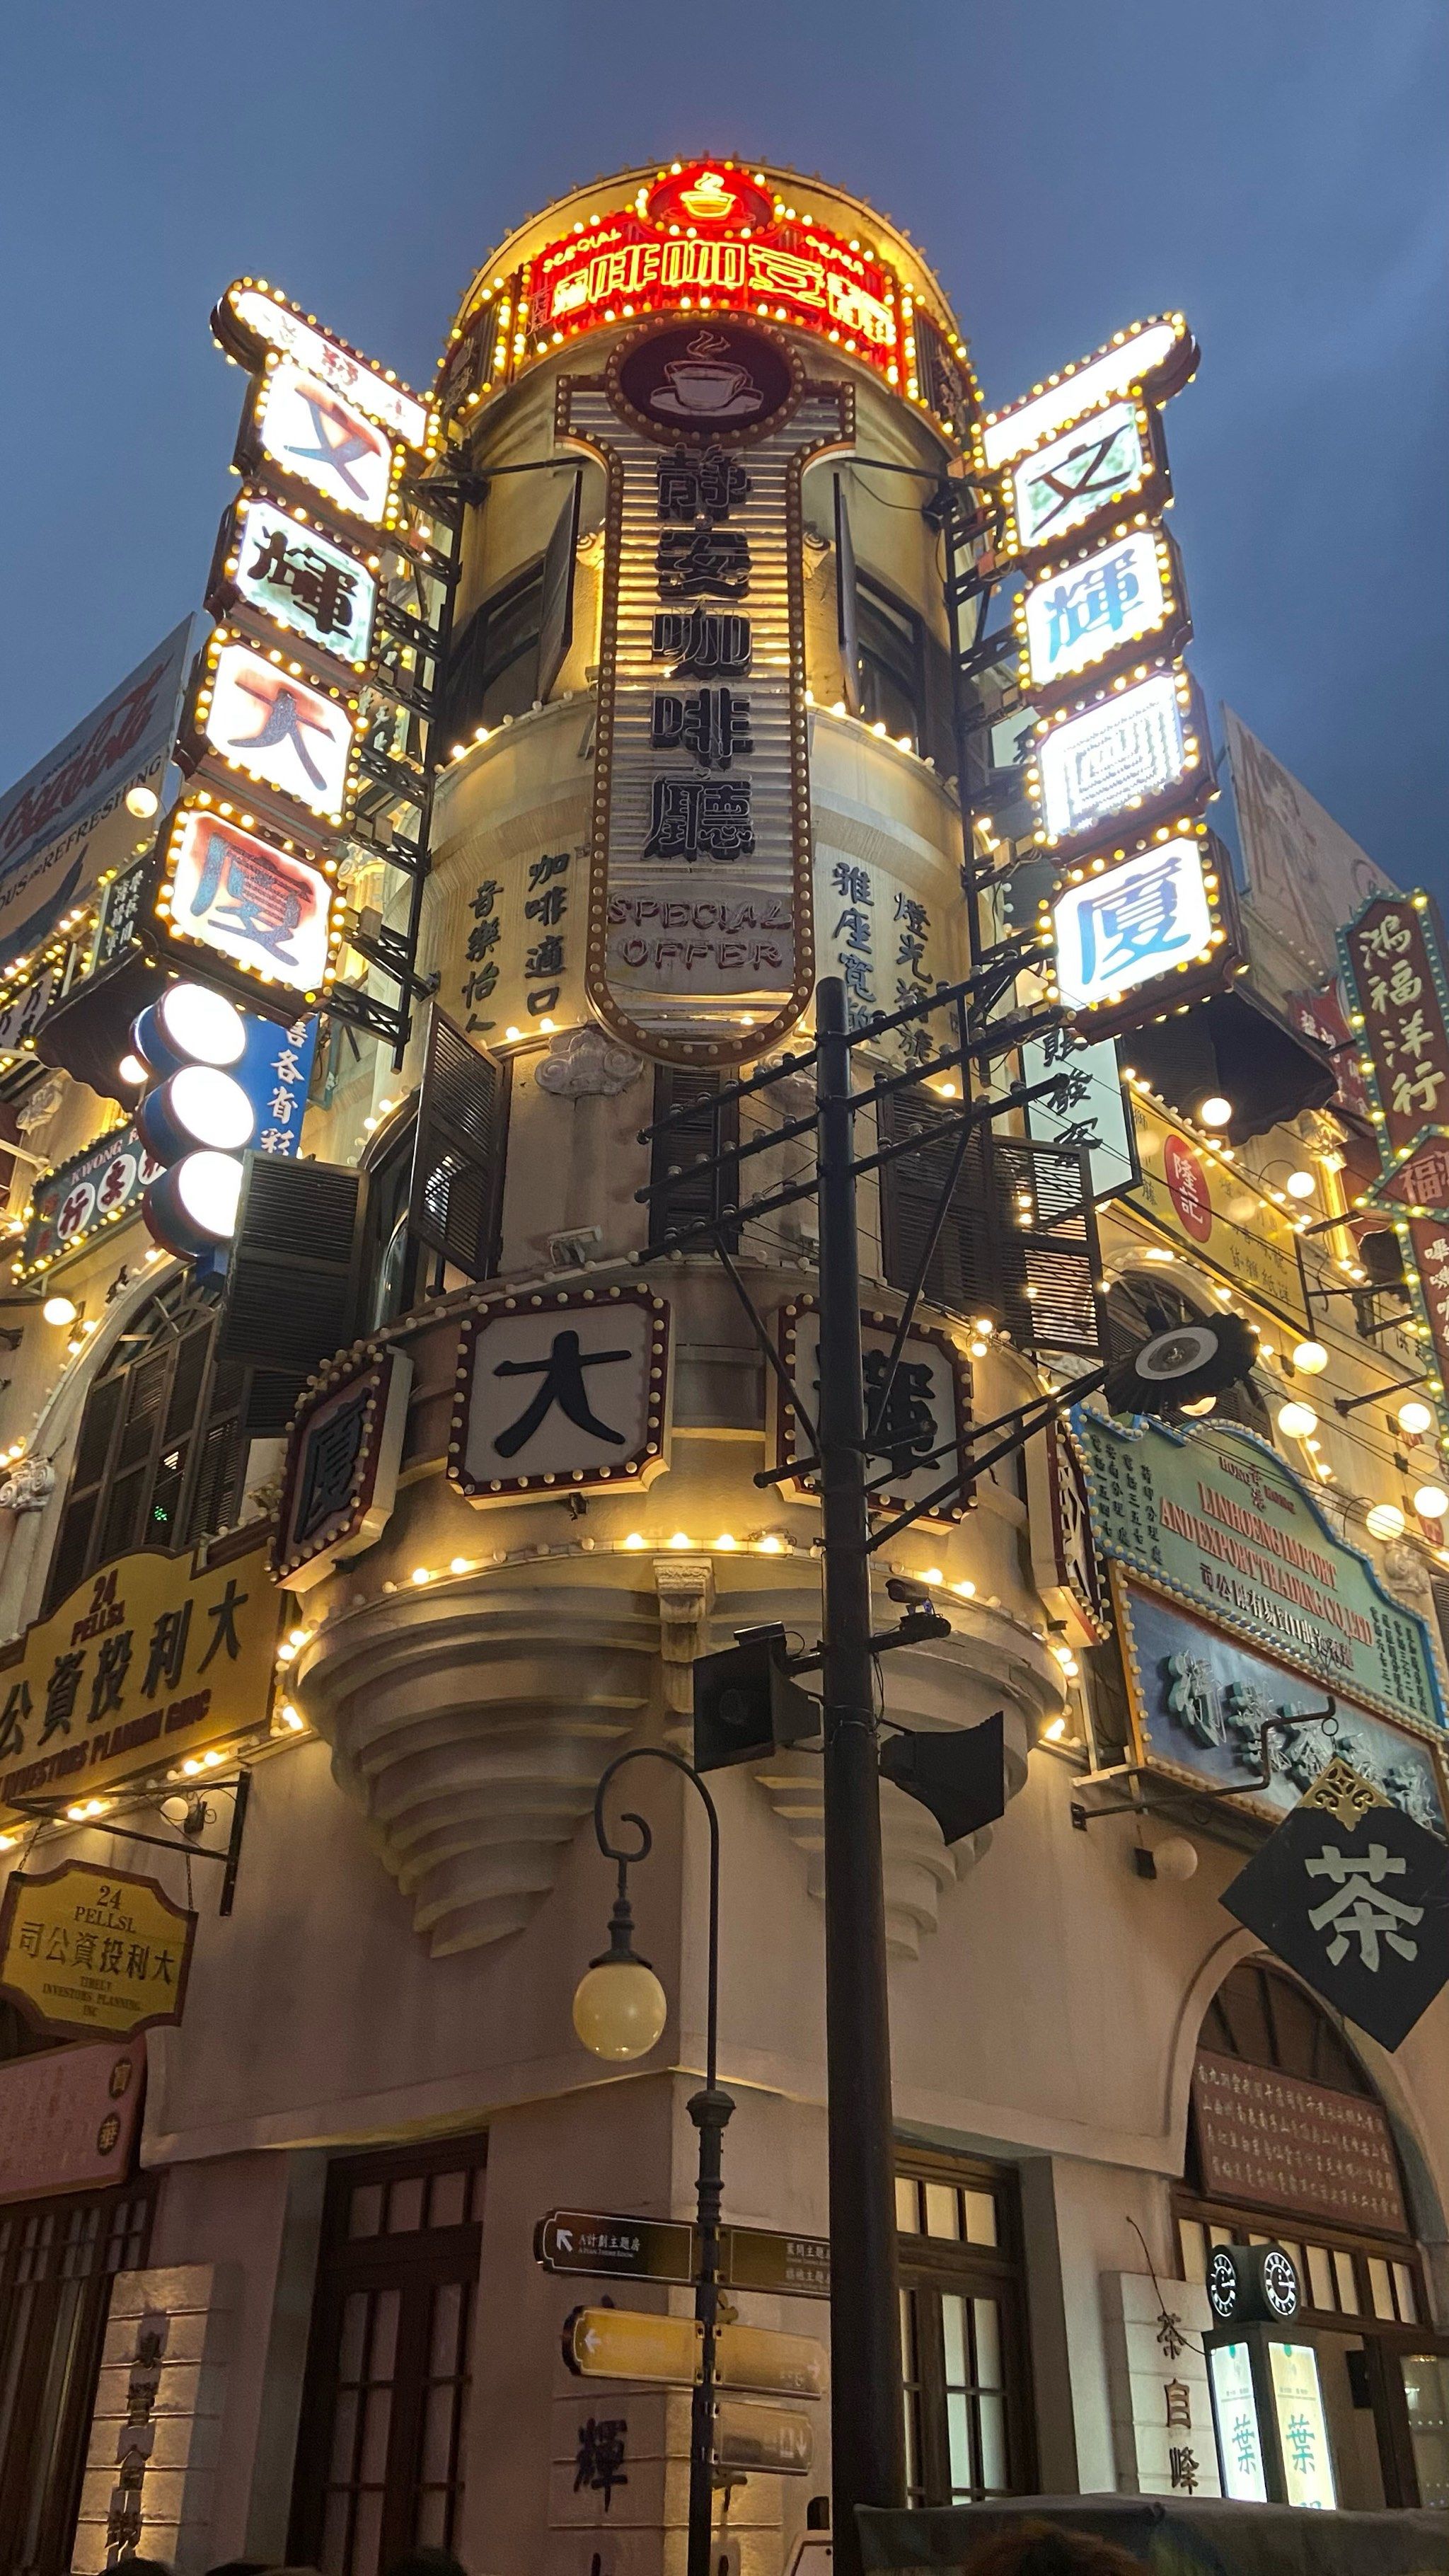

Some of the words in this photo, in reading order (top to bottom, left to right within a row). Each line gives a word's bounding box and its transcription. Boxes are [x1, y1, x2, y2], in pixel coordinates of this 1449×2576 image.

[607, 892, 793, 933] SPECIAL
[622, 938, 783, 971] OFFER
[1359, 914, 1447, 1117] 鴻福洋行
[1160, 1496, 1196, 1543] AND
[1196, 1517, 1258, 1580] EXPORT
[89, 1568, 119, 1614] 24
[96, 1885, 122, 1911] 24
[1304, 1843, 1424, 1972] 茶
